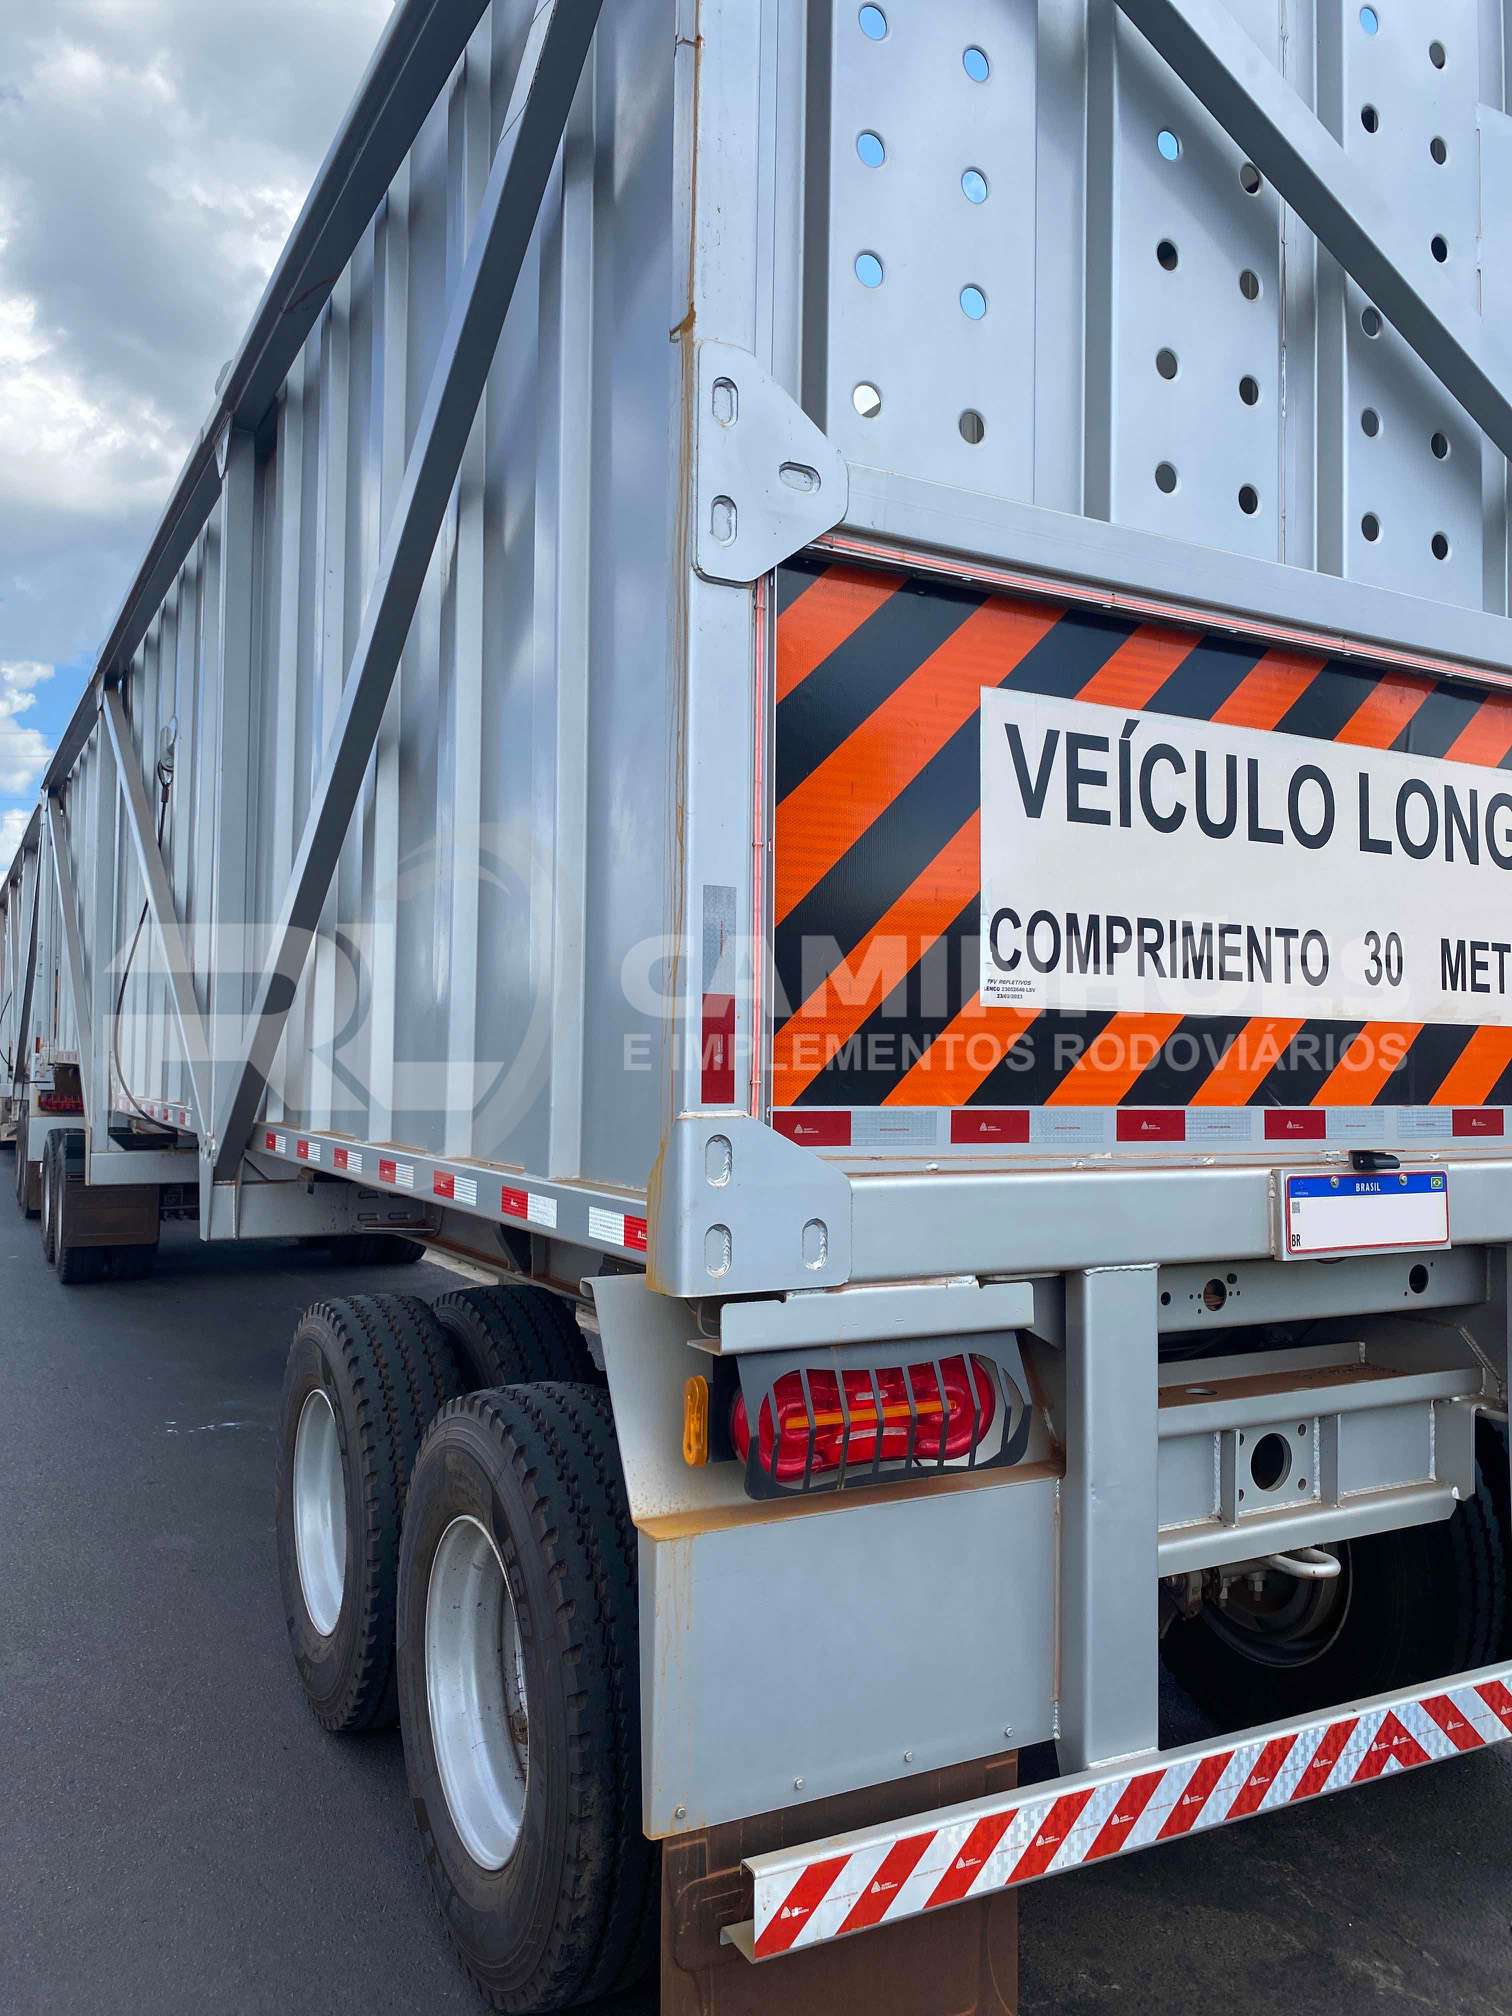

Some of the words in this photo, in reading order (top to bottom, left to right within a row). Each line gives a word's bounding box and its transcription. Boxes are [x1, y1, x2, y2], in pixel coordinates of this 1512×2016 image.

[1004, 718, 1335, 850] VEÍCULO
[1358, 771, 1512, 870] LONG
[989, 907, 1329, 987] COMPRIMENTO
[1363, 930, 1402, 987] 30
[1440, 937, 1512, 994] MET
[1355, 1181, 1381, 1193] BRASIL
[1291, 1233, 1301, 1247] BR
